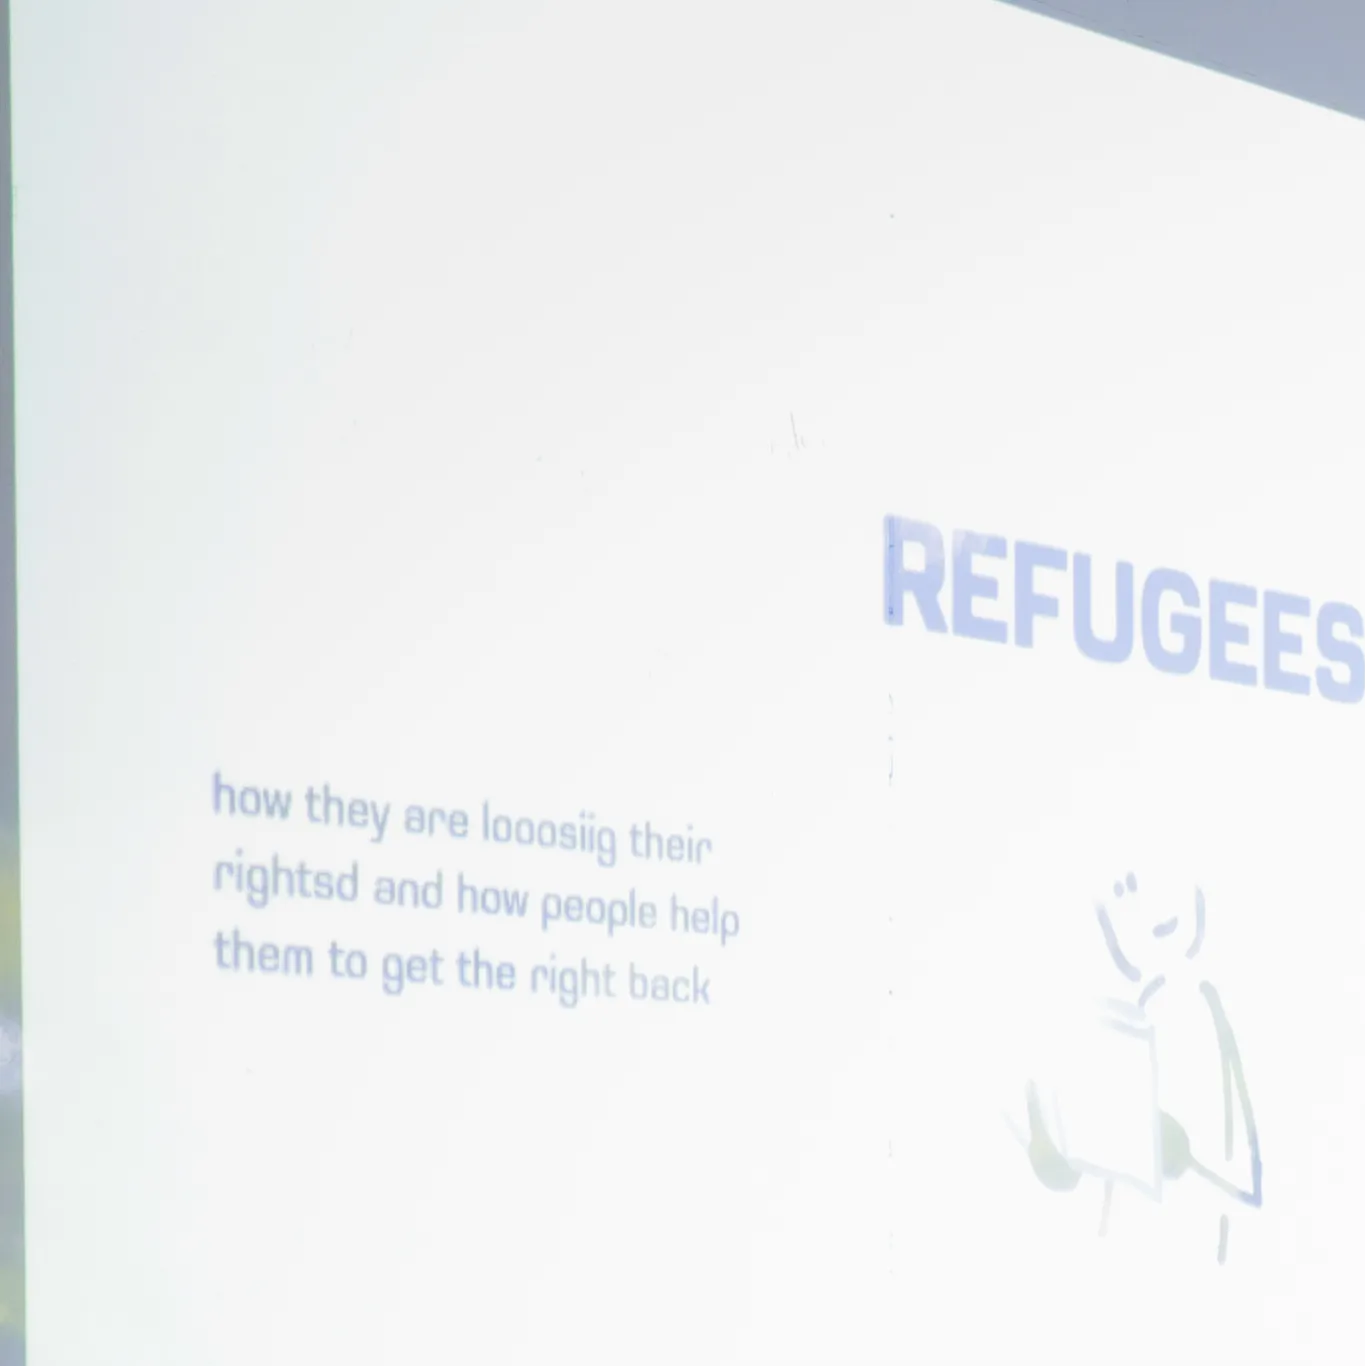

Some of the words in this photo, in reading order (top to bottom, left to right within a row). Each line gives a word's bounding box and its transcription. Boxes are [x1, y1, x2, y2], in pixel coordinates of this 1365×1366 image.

[883, 512, 1365, 705] REFUGEES
[212, 769, 293, 819] how
[304, 781, 390, 844] they
[404, 804, 469, 839] are
[482, 800, 617, 868] looosiig
[630, 821, 713, 864] their
[212, 847, 359, 909] rightsd
[374, 870, 443, 910] and
[457, 873, 529, 918] how
[541, 888, 657, 936] people
[670, 894, 740, 946] help
[212, 927, 314, 977] them
[328, 941, 368, 979] to
[382, 948, 444, 996] get
[456, 946, 517, 991] the
[531, 953, 615, 1008] right
[629, 961, 711, 1005] back
